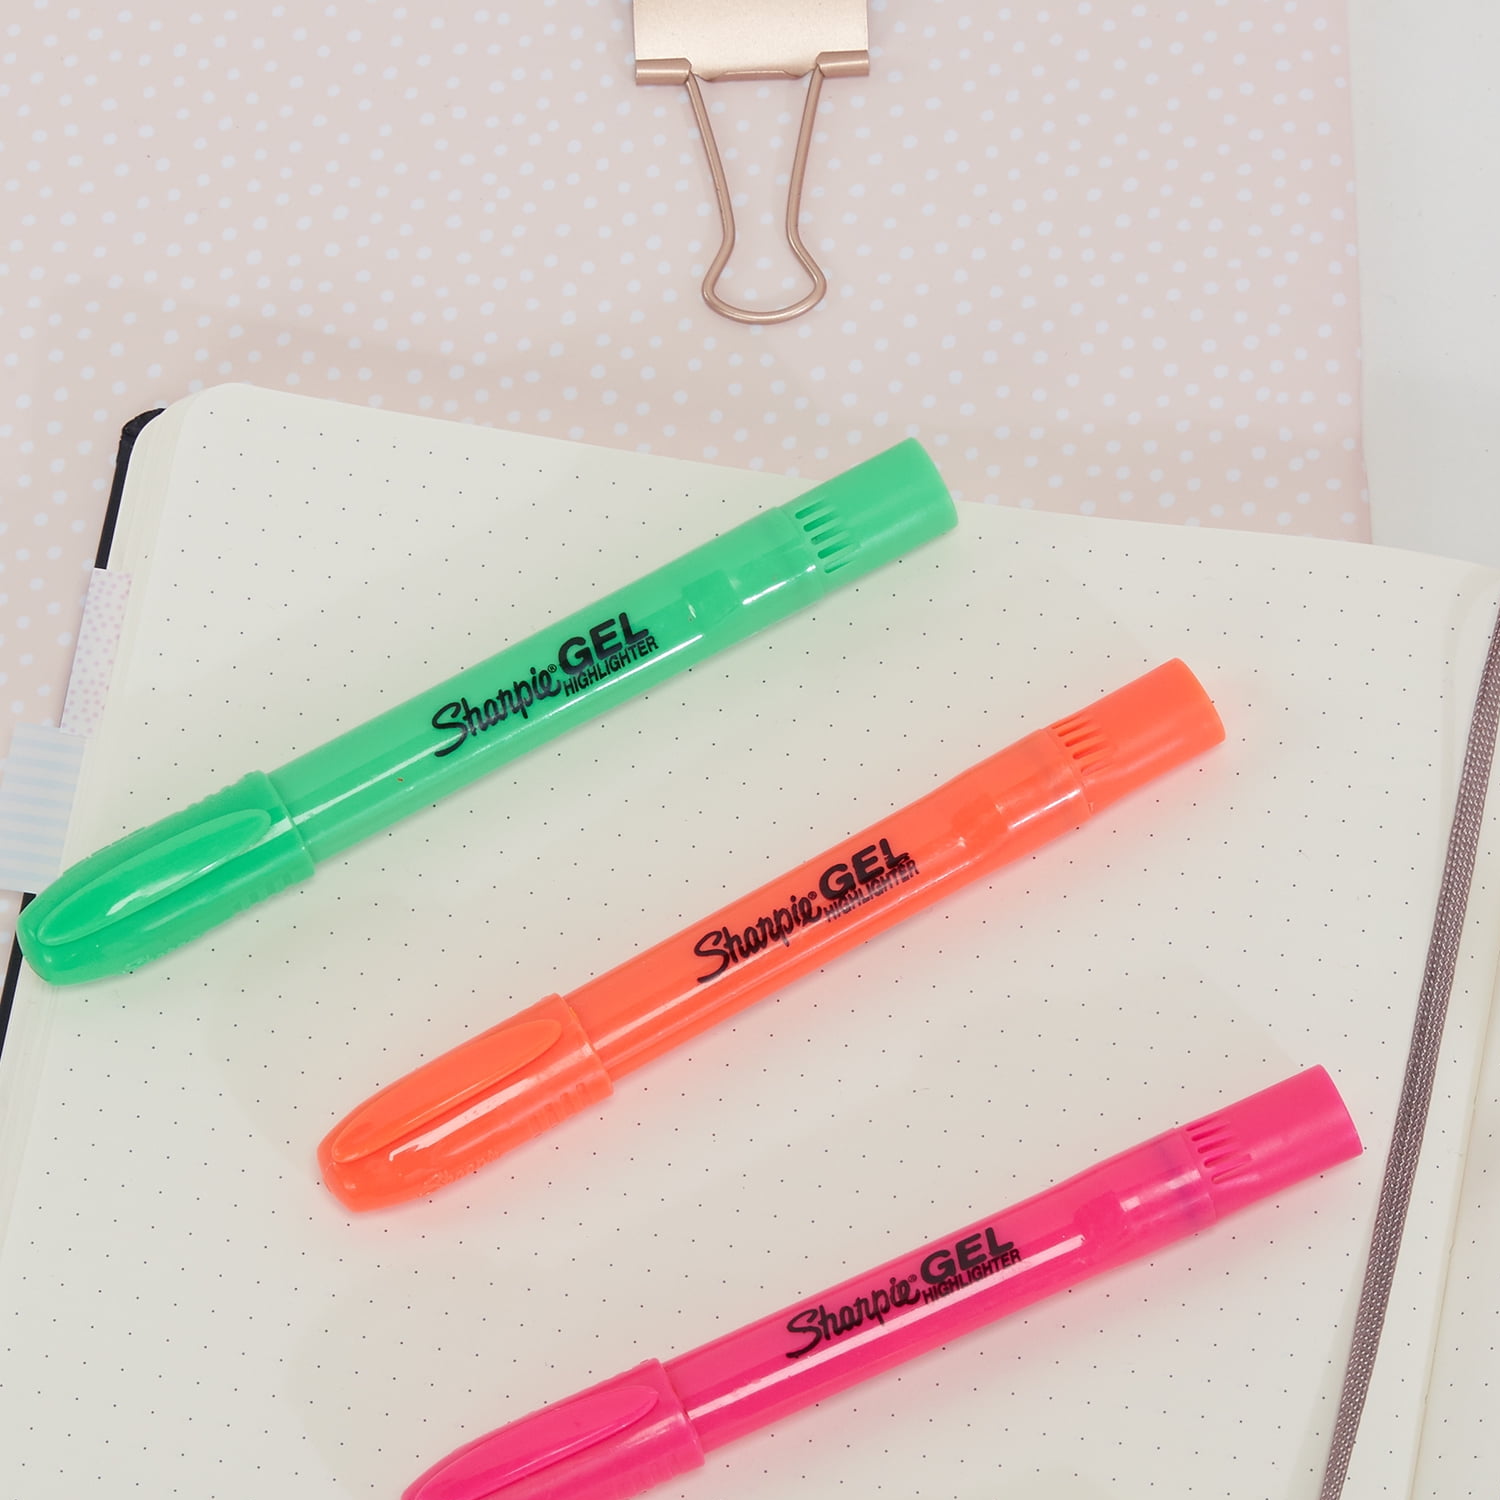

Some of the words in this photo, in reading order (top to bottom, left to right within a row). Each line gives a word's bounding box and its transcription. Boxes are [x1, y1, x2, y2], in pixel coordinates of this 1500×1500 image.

[558, 612, 649, 675] GEL
[564, 636, 659, 696] HIGHLIGHTER
[819, 838, 910, 900] GEL
[824, 860, 920, 922] HIGHLIGHTER
[920, 1227, 1014, 1284] GEL
[923, 1249, 1021, 1304] HIGHLIGHTER
